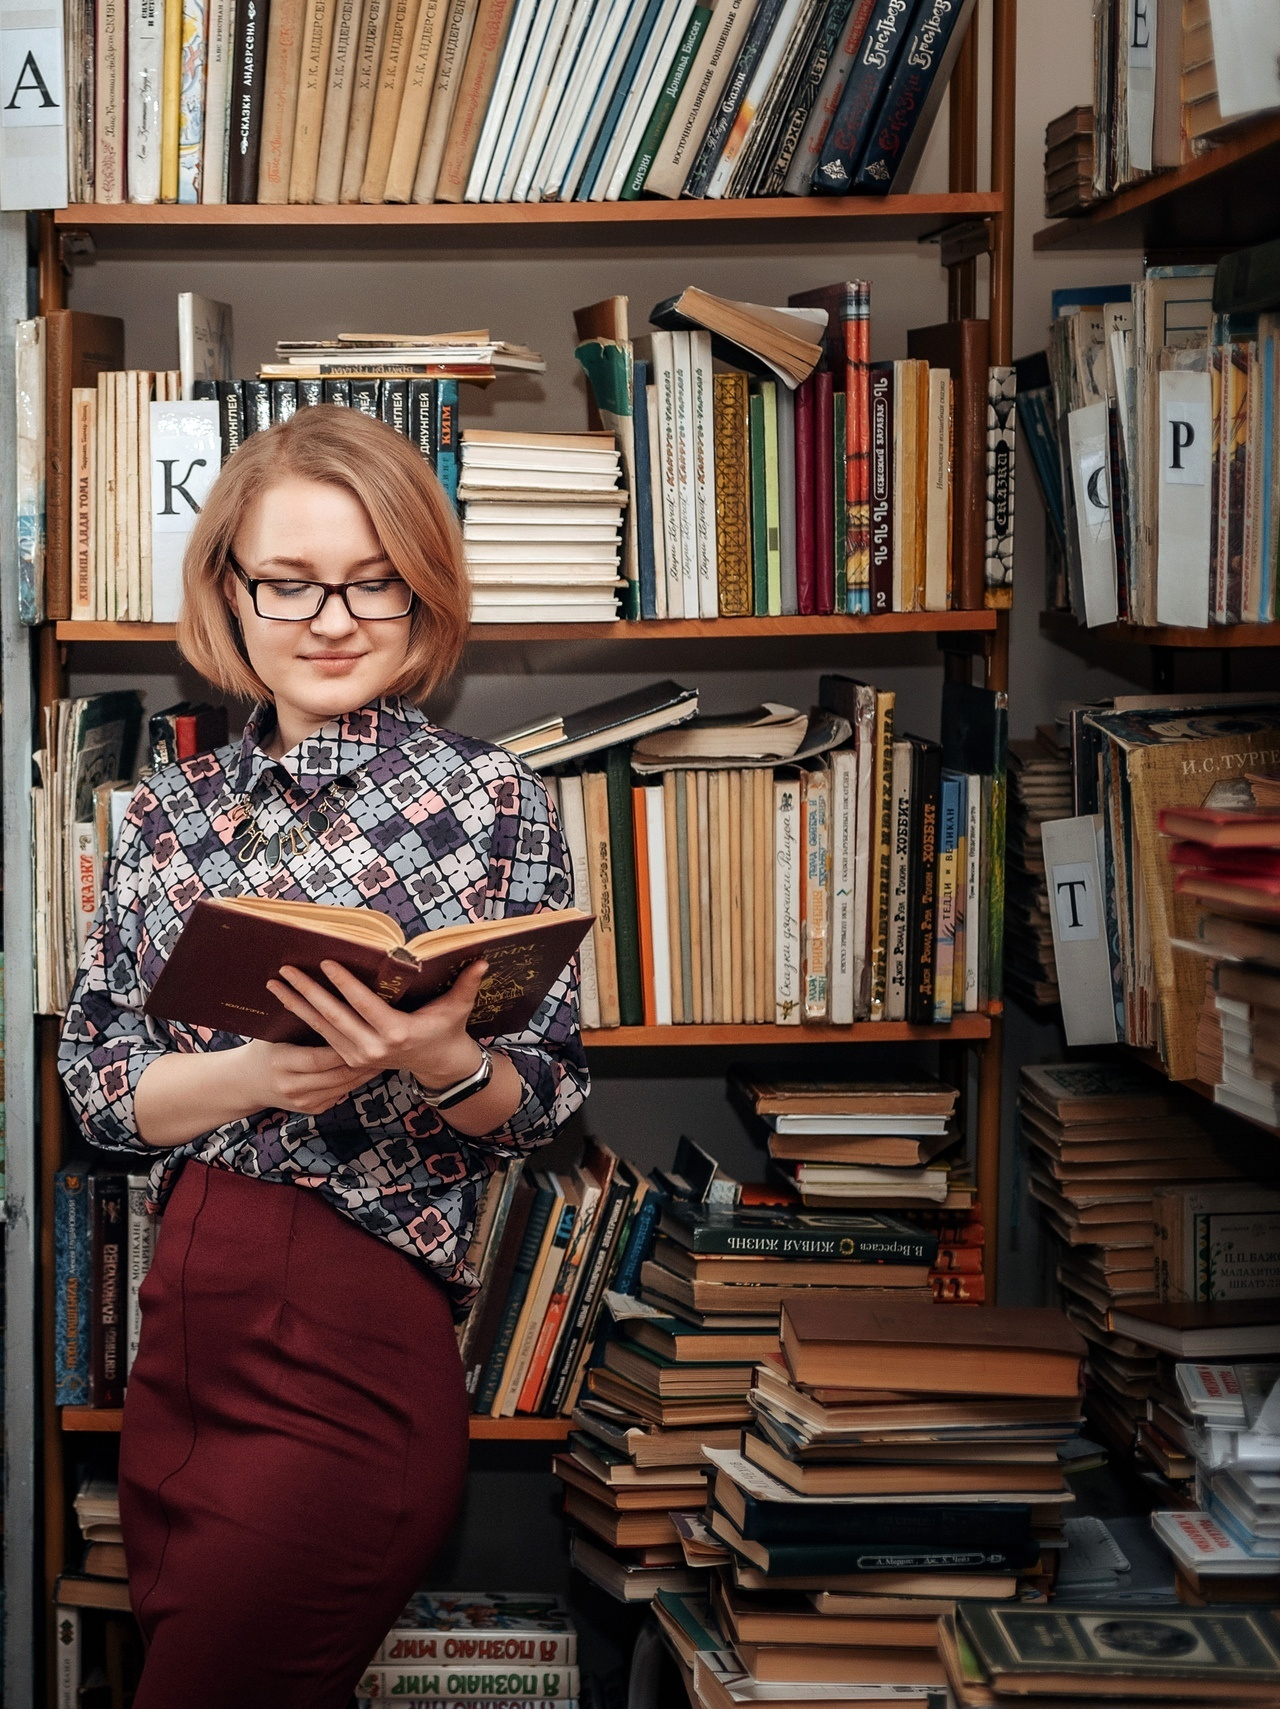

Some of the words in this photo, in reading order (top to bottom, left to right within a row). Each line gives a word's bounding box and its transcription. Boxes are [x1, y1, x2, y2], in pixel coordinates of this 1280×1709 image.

[1131, 0, 1150, 48] Е
[242, 21, 256, 87] АНДЕРСЕНА
[666, 52, 690, 97] Дональд
[682, 19, 702, 55] Биссет
[4, 50, 60, 110] А
[673, 69, 714, 165] ВОСТОЧНОСЛАВЯНСКИЕ
[710, 11, 737, 66] ВОЛШЕБНЫЕ
[722, 72, 747, 113] Сказки
[241, 95, 251, 138] СКАЗКИ
[394, 392, 403, 436] УНГЛЕЙ
[938, 381, 946, 403] сказка
[420, 392, 430, 453] ДЖУНГЛЕЙ
[441, 405, 451, 445] КИМ
[936, 405, 945, 441] волшебная
[1169, 420, 1195, 469] Р
[156, 459, 208, 516] К
[935, 443, 945, 490] Итальянская
[79, 477, 88, 509] ТОМА
[79, 512, 89, 546] ДЯДИ
[79, 549, 89, 601] ХИЖИНА
[777, 816, 796, 872] Римуса
[896, 797, 908, 856] ХОББИТ
[922, 803, 936, 862] ХОББИТ
[944, 807, 954, 861] ВЕЛИКАН
[82, 854, 94, 913] СКАЗКИ
[780, 874, 797, 940] дядюшки
[942, 882, 952, 920] ТЕДДИ
[1057, 880, 1087, 928] Т
[779, 945, 797, 998] Сказки
[601, 1199, 623, 1248] ЭЛЕКТРОНИКА
[727, 1236, 779, 1251] ЖИЗНЬ
[783, 1239, 835, 1253] ЖИВАЯ
[132, 1222, 140, 1280] МОГИКАНЕ
[143, 1228, 151, 1274] ПАРИЖА
[388, 1638, 437, 1660] МИР
[444, 1638, 535, 1660] ПОЗНАЮ
[540, 1639, 558, 1662] Я
[391, 1673, 441, 1696] МИР
[447, 1673, 538, 1696] ПОЗНАЮ
[543, 1673, 560, 1697] Я
